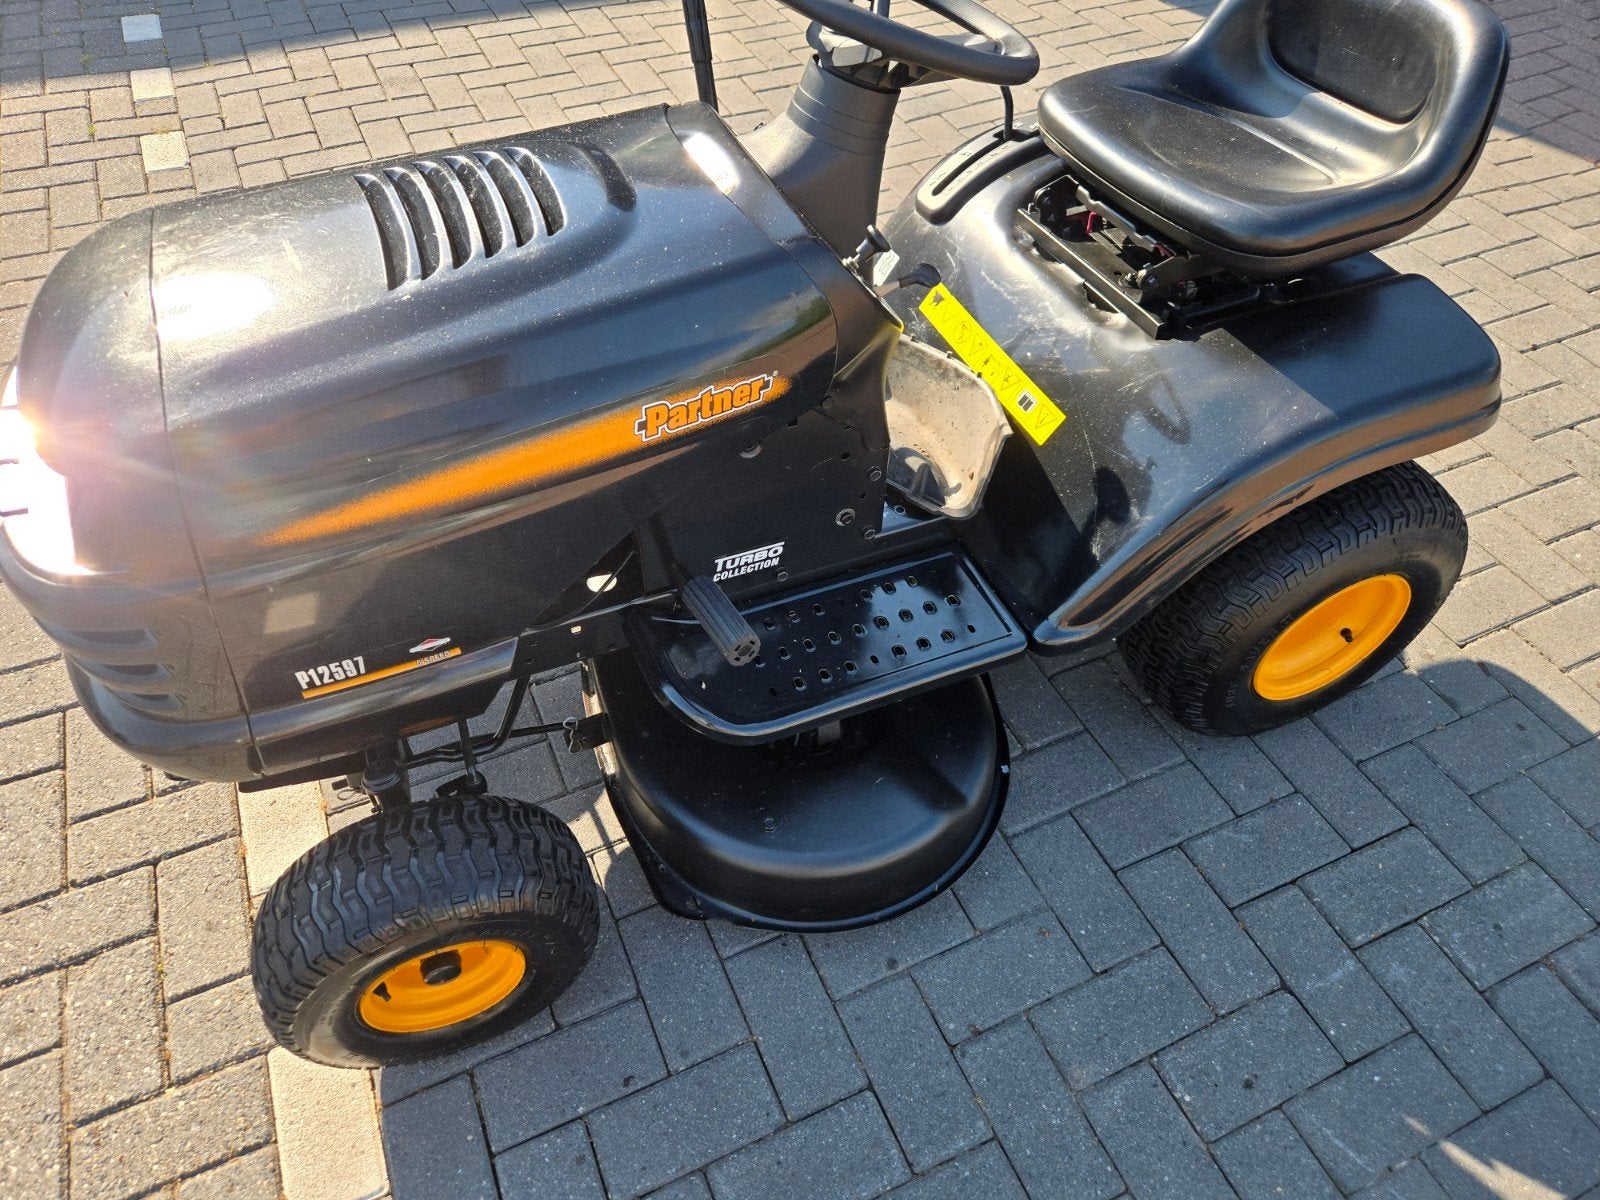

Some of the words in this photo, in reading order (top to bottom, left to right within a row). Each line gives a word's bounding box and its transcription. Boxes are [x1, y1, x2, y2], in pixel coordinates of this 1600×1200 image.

[639, 375, 769, 441] Partner
[713, 556, 780, 582] COLLECTION
[714, 541, 785, 572] TURBO
[294, 655, 366, 690] P12597
